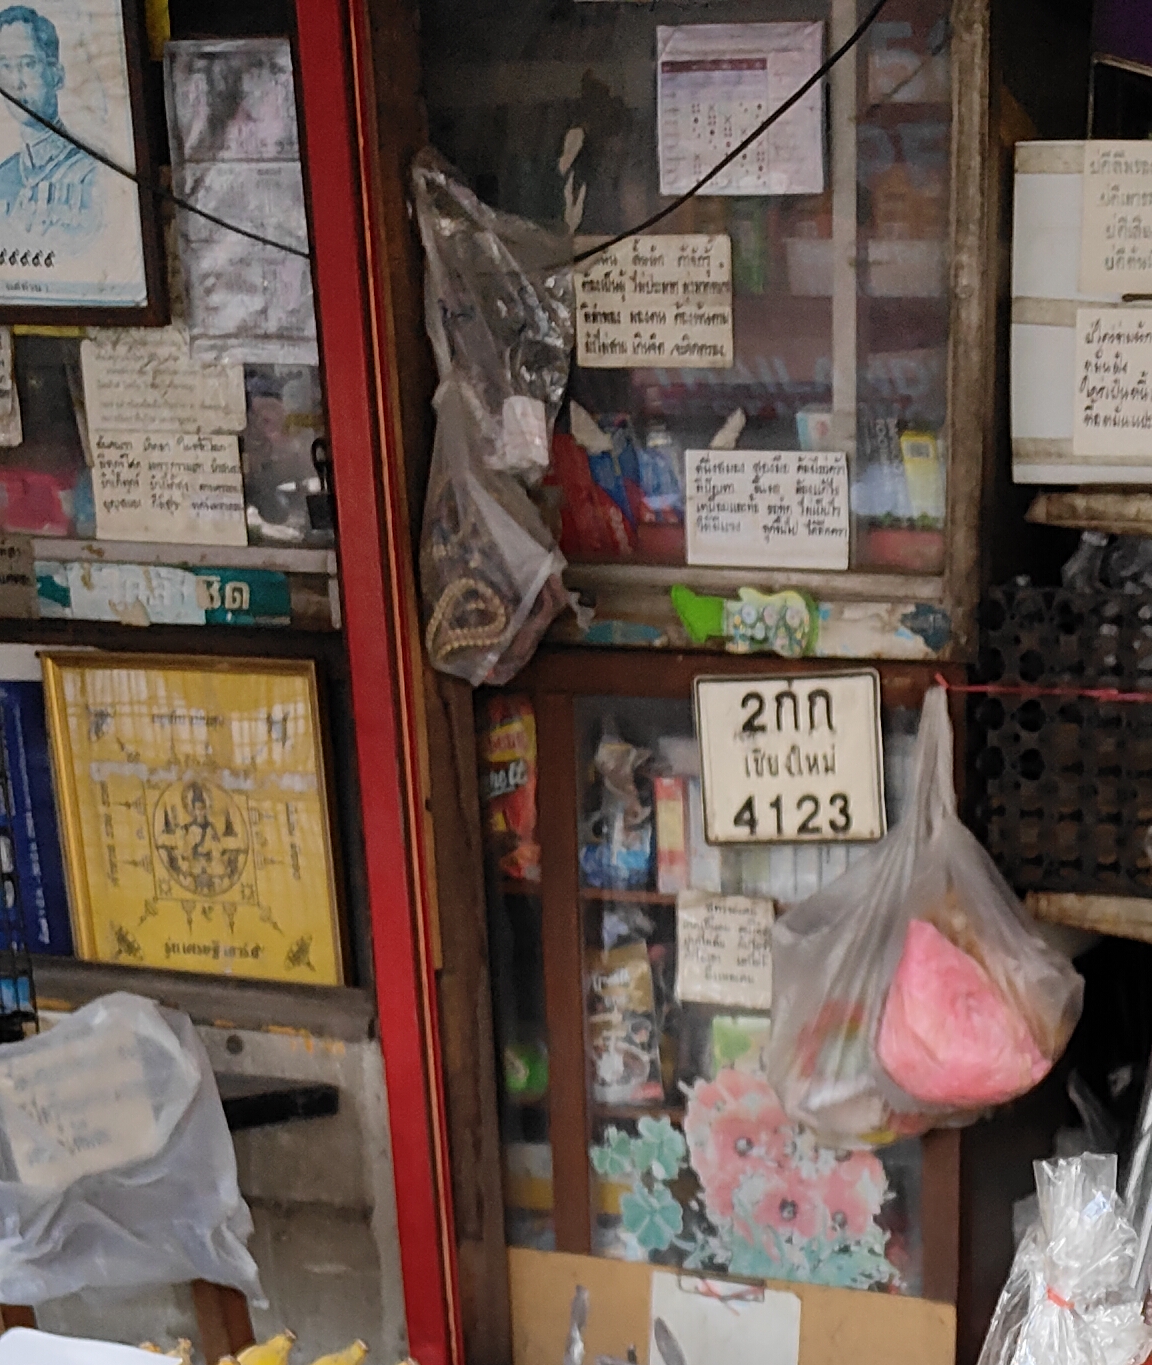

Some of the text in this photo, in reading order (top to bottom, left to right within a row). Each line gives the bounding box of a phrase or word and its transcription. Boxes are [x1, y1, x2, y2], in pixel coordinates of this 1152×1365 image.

[741, 688, 834, 733] 2กก
[745, 743, 837, 779] เชียงใหม่
[733, 792, 852, 836] 4123
